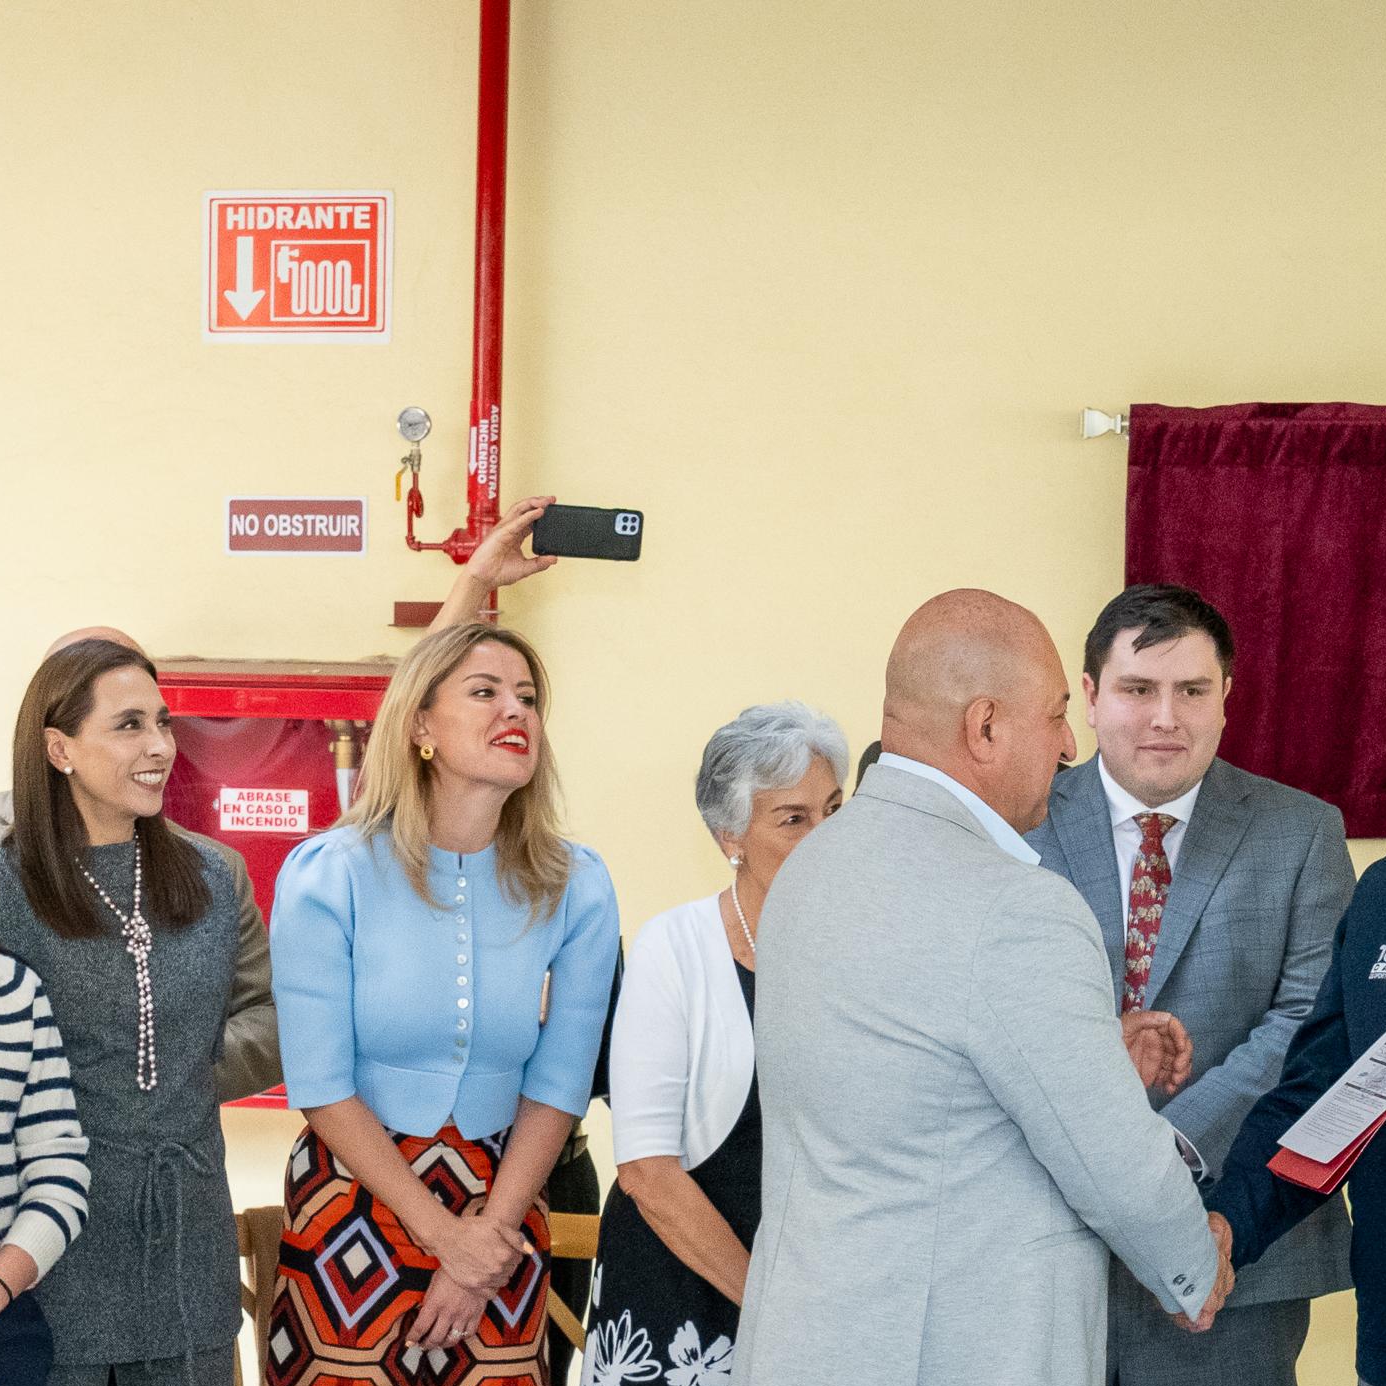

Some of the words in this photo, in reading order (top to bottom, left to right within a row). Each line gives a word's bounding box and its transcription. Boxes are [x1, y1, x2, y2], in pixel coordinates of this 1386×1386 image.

[226, 205, 371, 230] HIDRANTE
[490, 404, 500, 442] AGUA
[477, 419, 489, 485] INCENDIO
[488, 444, 499, 500] CONTRA
[231, 514, 260, 536] NO
[263, 514, 360, 537] OBSTRUIR
[237, 792, 292, 802] ABRASE
[223, 804, 241, 813] EN
[246, 804, 283, 814] CASO
[288, 805, 306, 815] DE
[231, 816, 298, 827] INCENDIO
